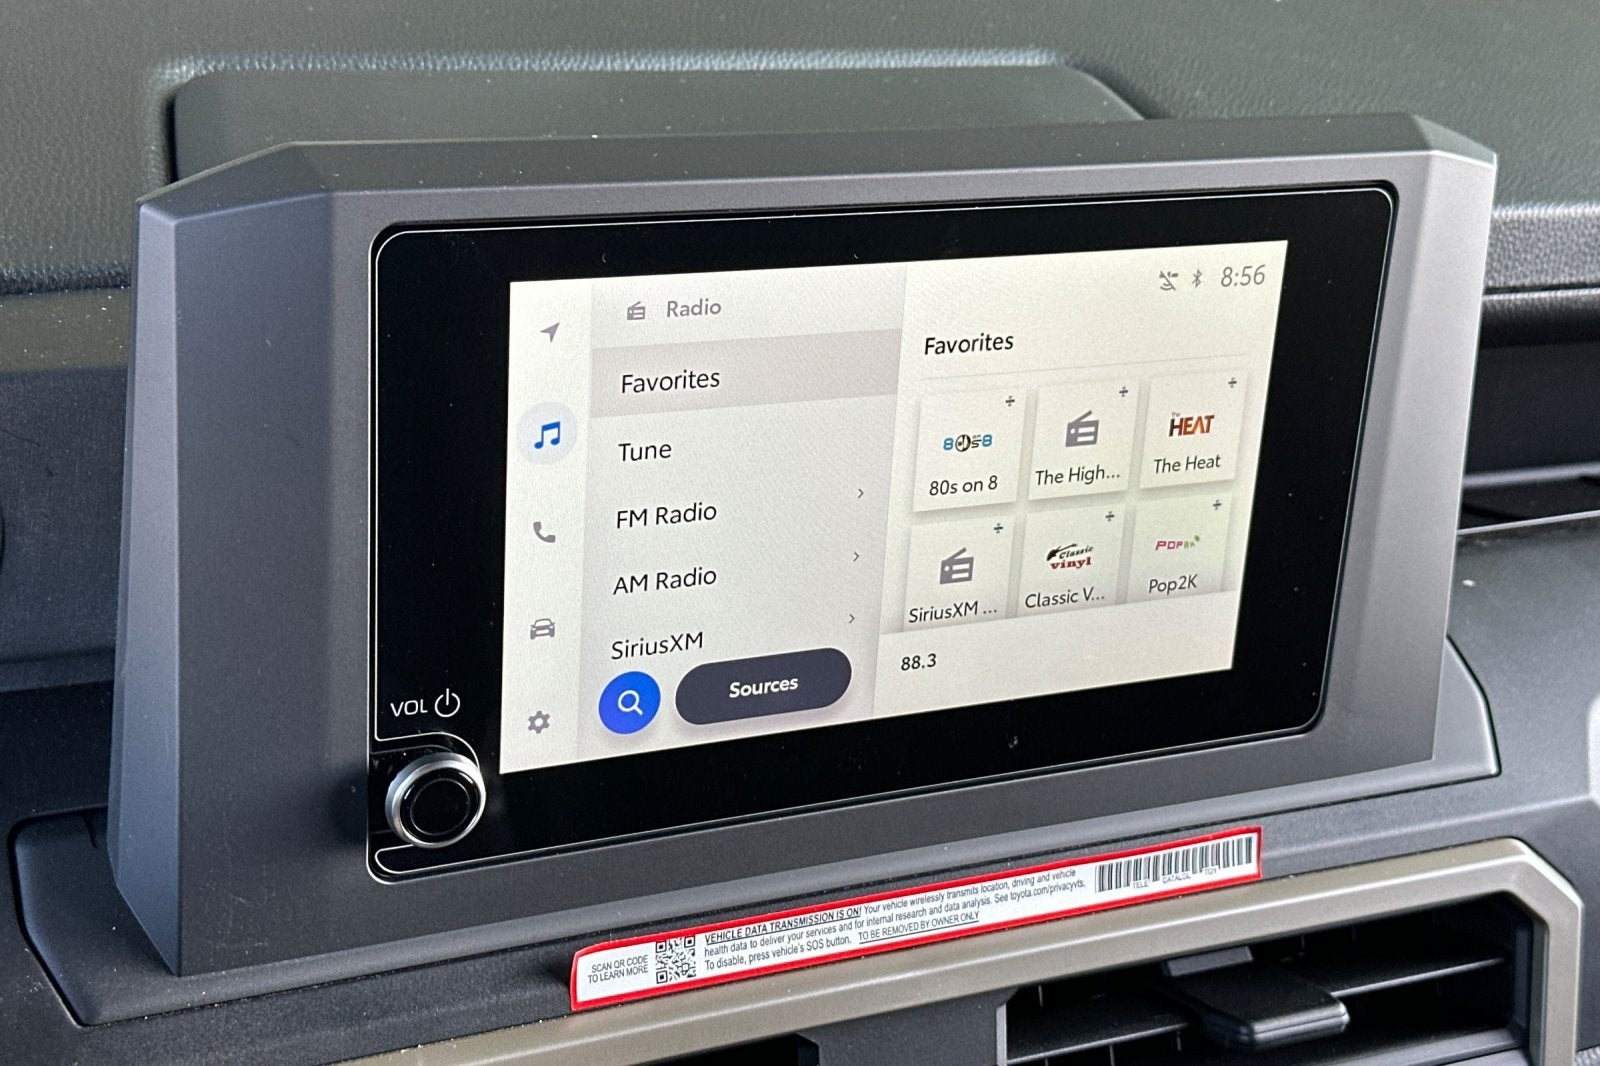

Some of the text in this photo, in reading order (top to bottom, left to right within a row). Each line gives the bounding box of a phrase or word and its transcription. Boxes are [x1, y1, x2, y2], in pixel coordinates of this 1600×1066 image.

[1220, 264, 1266, 288] 8:56
[666, 298, 722, 318] Radio
[923, 332, 1014, 356] Favorites
[620, 369, 720, 394] Favorites
[1168, 415, 1215, 437] HEAT
[618, 440, 672, 462] Tune
[1035, 464, 1121, 486] The High...
[1154, 454, 1221, 475] The Heat
[928, 476, 998, 496] 80s on 8
[616, 502, 717, 529] FM Radio
[1050, 557, 1092, 570] vinyl
[1058, 545, 1094, 560] Classic
[612, 566, 717, 595] AM Radio
[1148, 574, 1199, 594] Pop2K
[1024, 588, 1079, 610] Classic
[908, 600, 978, 624] SiriusXM
[611, 632, 704, 660] SiriusXM
[900, 653, 937, 671] 88.3
[729, 676, 799, 698] Sources
[390, 698, 428, 717] VOL
[704, 868, 1076, 944] VEHICLE DATA TRANSMISSION IS ON! Your vehicle wirelessly transmits location, driving and vehicle
[704, 941, 729, 957] health
[730, 938, 748, 952] data
[750, 938, 758, 950] to
[760, 932, 785, 948] deliver
[787, 930, 804, 946] your
[806, 924, 836, 939] services
[838, 919, 853, 932] and
[854, 918, 865, 929] for
[866, 910, 894, 927] internal
[896, 904, 927, 920] research
[928, 902, 943, 915] and
[944, 898, 960, 912] data
[962, 893, 992, 910] analysis.
[994, 892, 1009, 904] See
[704, 910, 980, 971] To disable, press vehicle's SOS button. TO BE REMOVED BY OWNER ONLY
[588, 964, 648, 984] TO LEARN MORE
[592, 954, 648, 974] SCAN QR CODE
